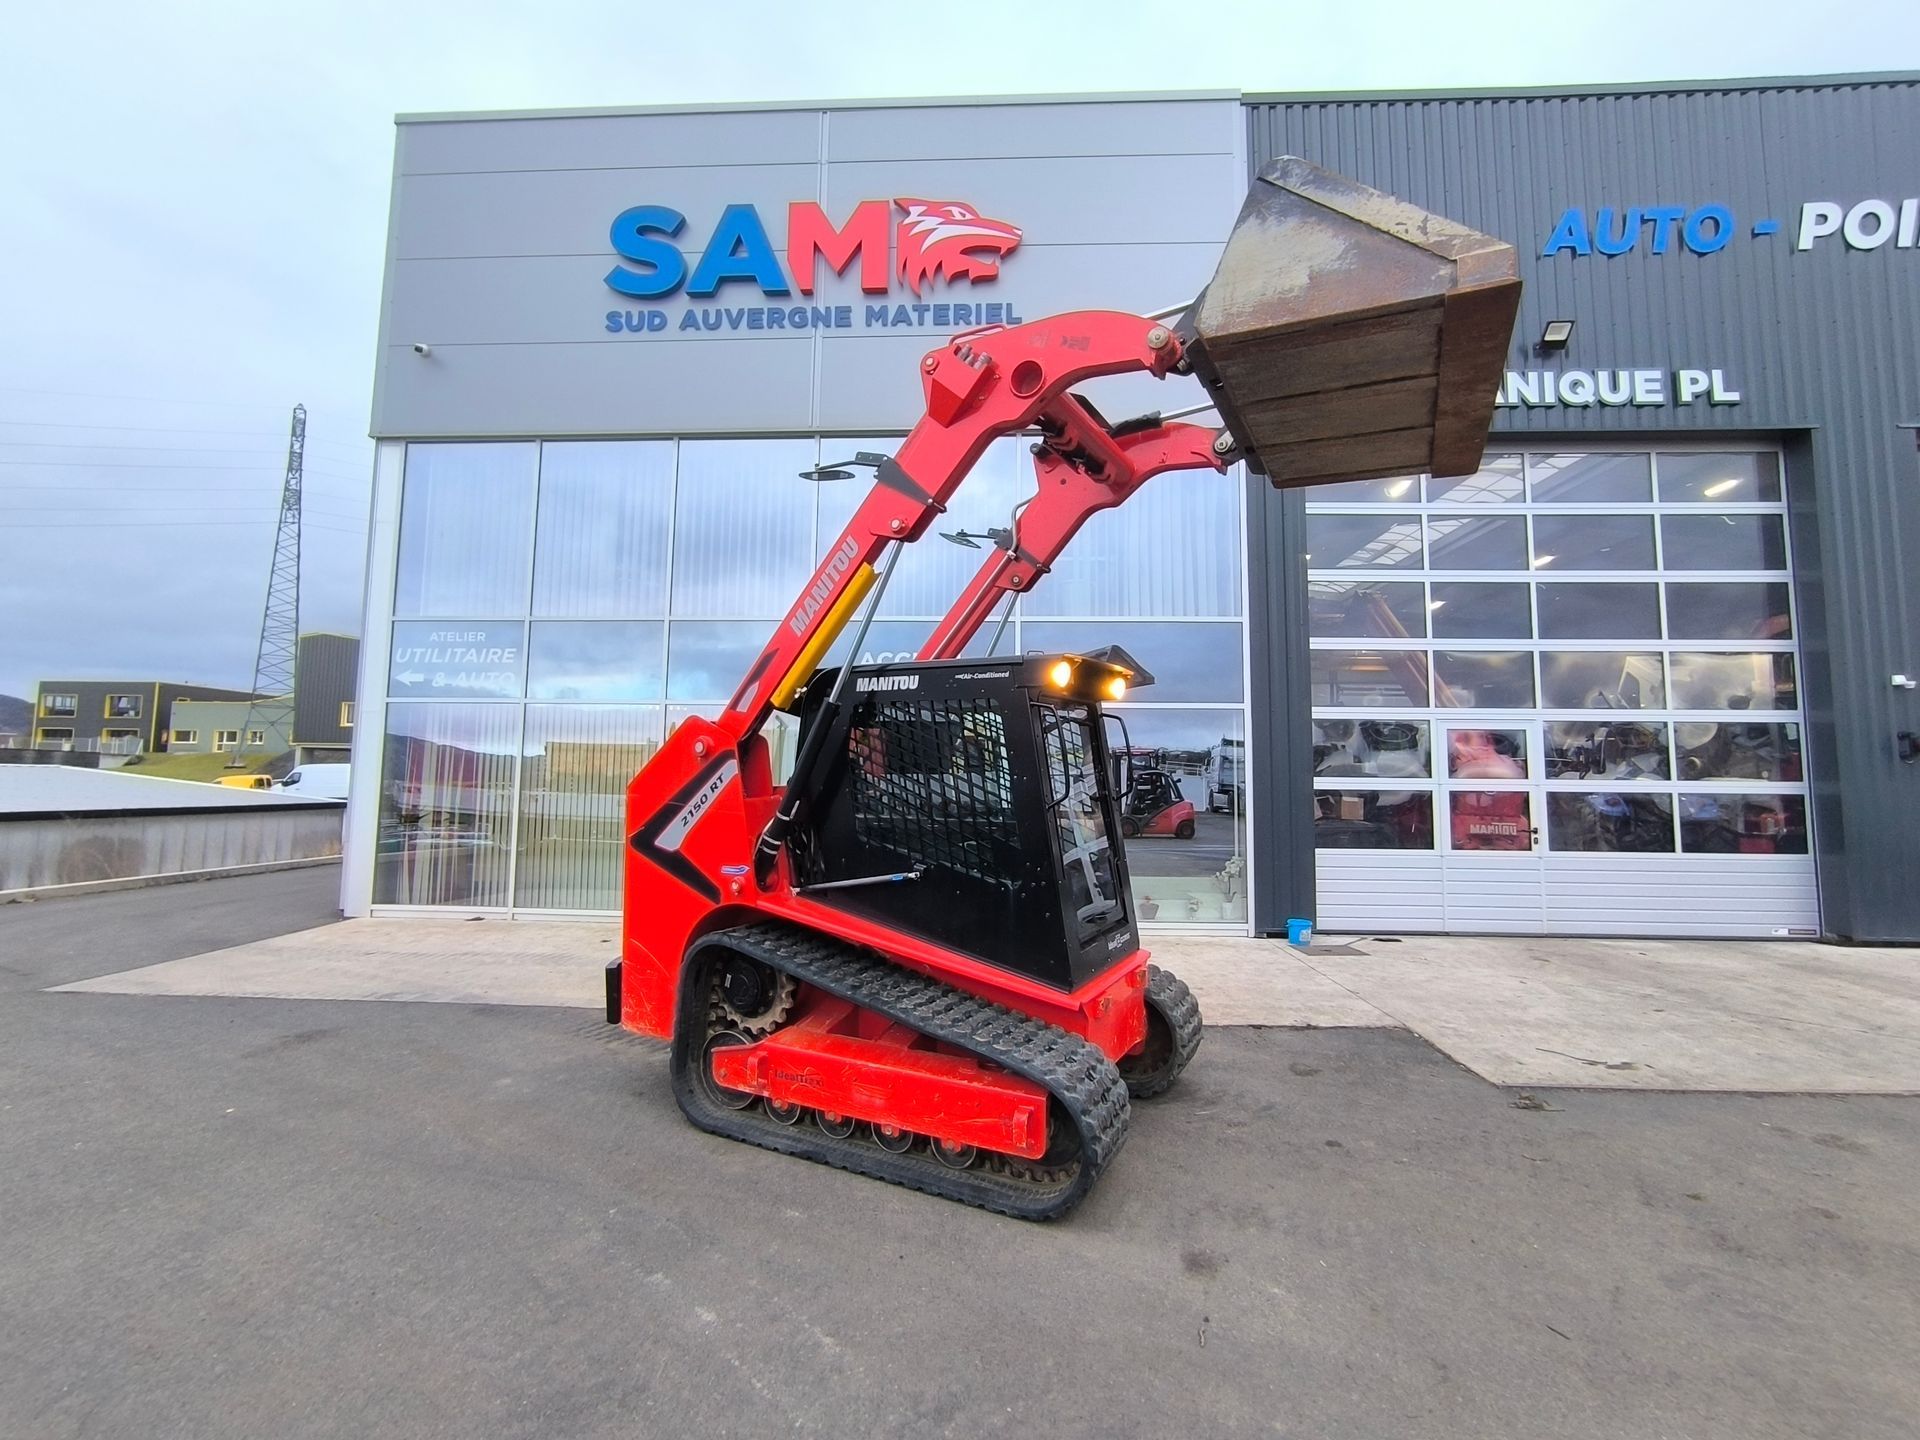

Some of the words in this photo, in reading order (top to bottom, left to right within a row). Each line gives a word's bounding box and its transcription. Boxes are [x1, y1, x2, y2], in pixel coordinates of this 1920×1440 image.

[1543, 204, 1734, 257] AUTO
[1798, 198, 1920, 250] POI
[603, 199, 891, 299] SAM
[605, 309, 668, 333] SUD
[679, 305, 853, 331] AUVERGNE
[865, 302, 1023, 328] MATERIEL
[1495, 369, 1666, 406] NIQUE
[1678, 369, 1741, 404] PL
[789, 536, 860, 637] MANITOU
[430, 631, 487, 642] ATELIER
[395, 647, 518, 664] UTILITAIRE
[431, 671, 447, 688] &
[452, 671, 516, 688] AUTO
[856, 675, 920, 692] MANITOU
[963, 670, 1010, 680] Air-Conditioned
[681, 793, 709, 828] 2150
[709, 772, 724, 794] RT
[1469, 822, 1518, 836] MANITOU
